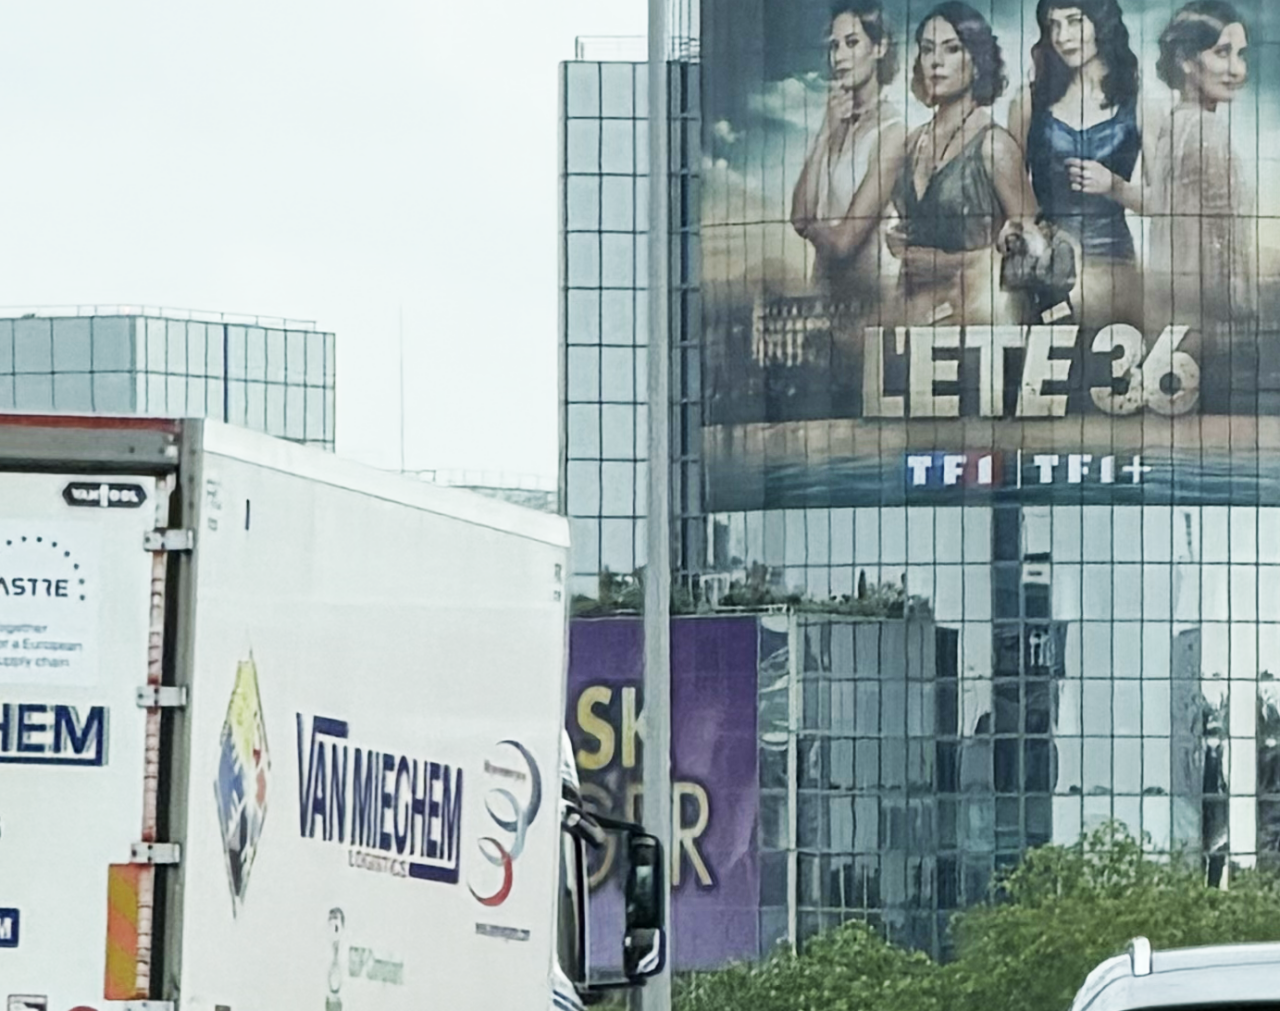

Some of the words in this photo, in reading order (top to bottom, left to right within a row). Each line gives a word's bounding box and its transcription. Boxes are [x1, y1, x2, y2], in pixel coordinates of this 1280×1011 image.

[1089, 322, 1201, 417] 36
[907, 454, 993, 486] TF1
[296, 712, 349, 843] VAN
